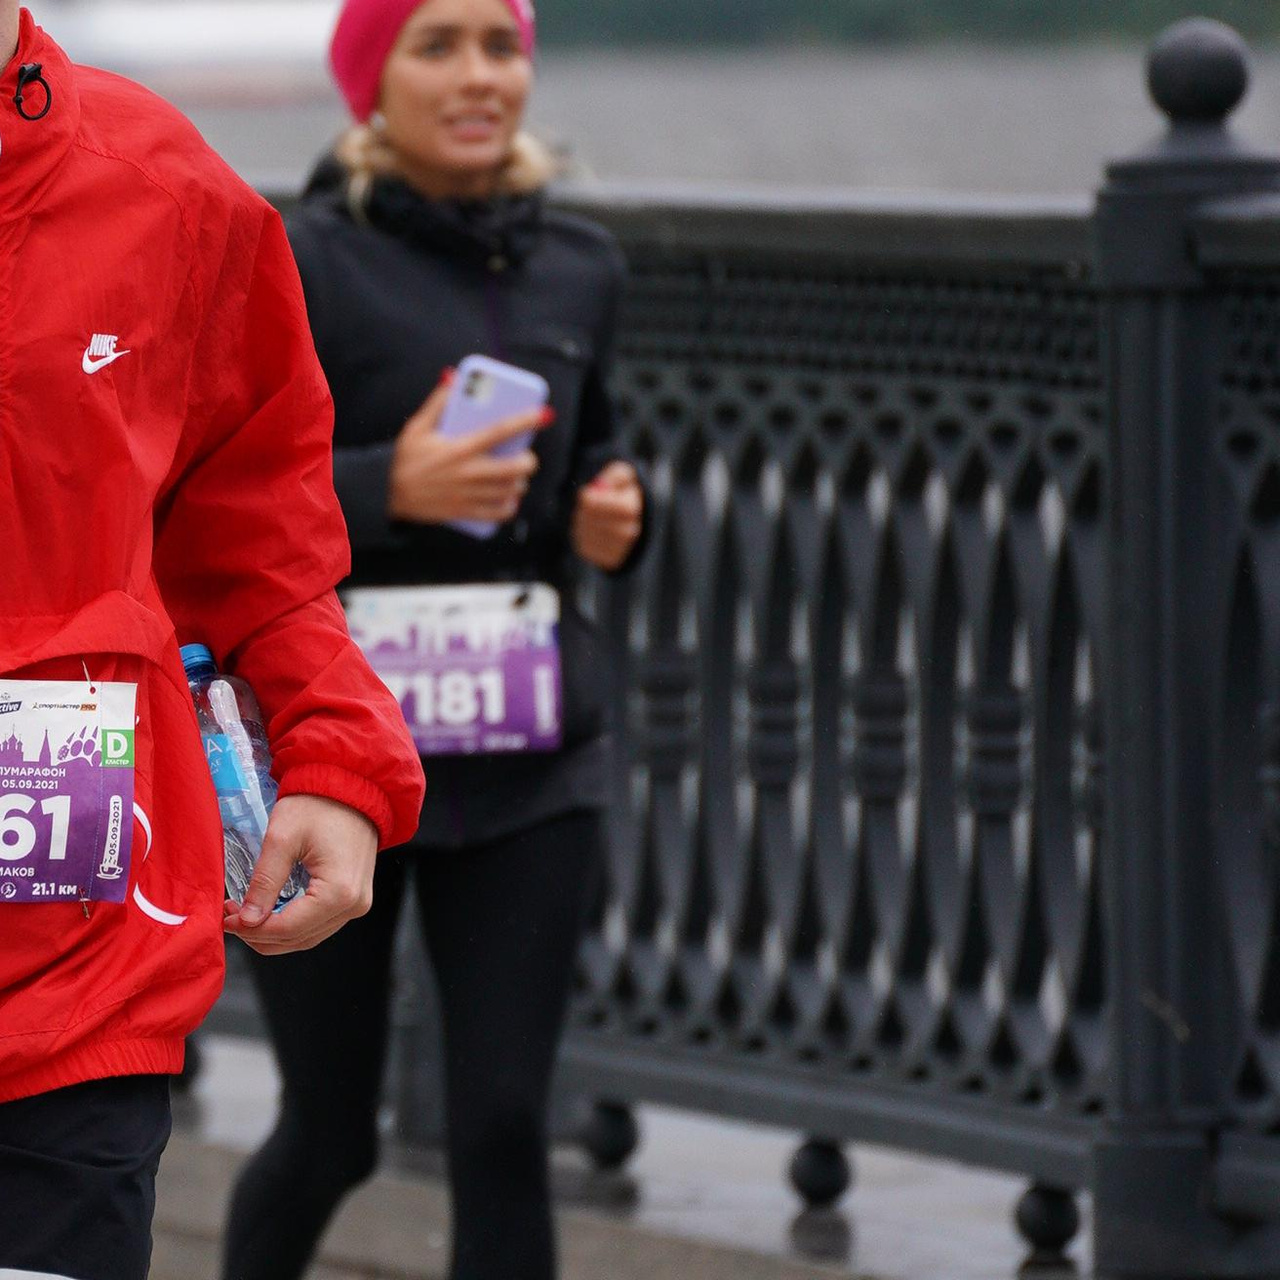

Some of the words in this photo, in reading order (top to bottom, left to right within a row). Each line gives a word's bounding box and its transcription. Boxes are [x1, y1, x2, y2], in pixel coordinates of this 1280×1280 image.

[89, 333, 118, 357] NIKE
[106, 732, 128, 759] D
[2, 779, 59, 790] 05.09.2021
[109, 801, 121, 854] 05.09.2021
[32, 882, 55, 896] 21.1
